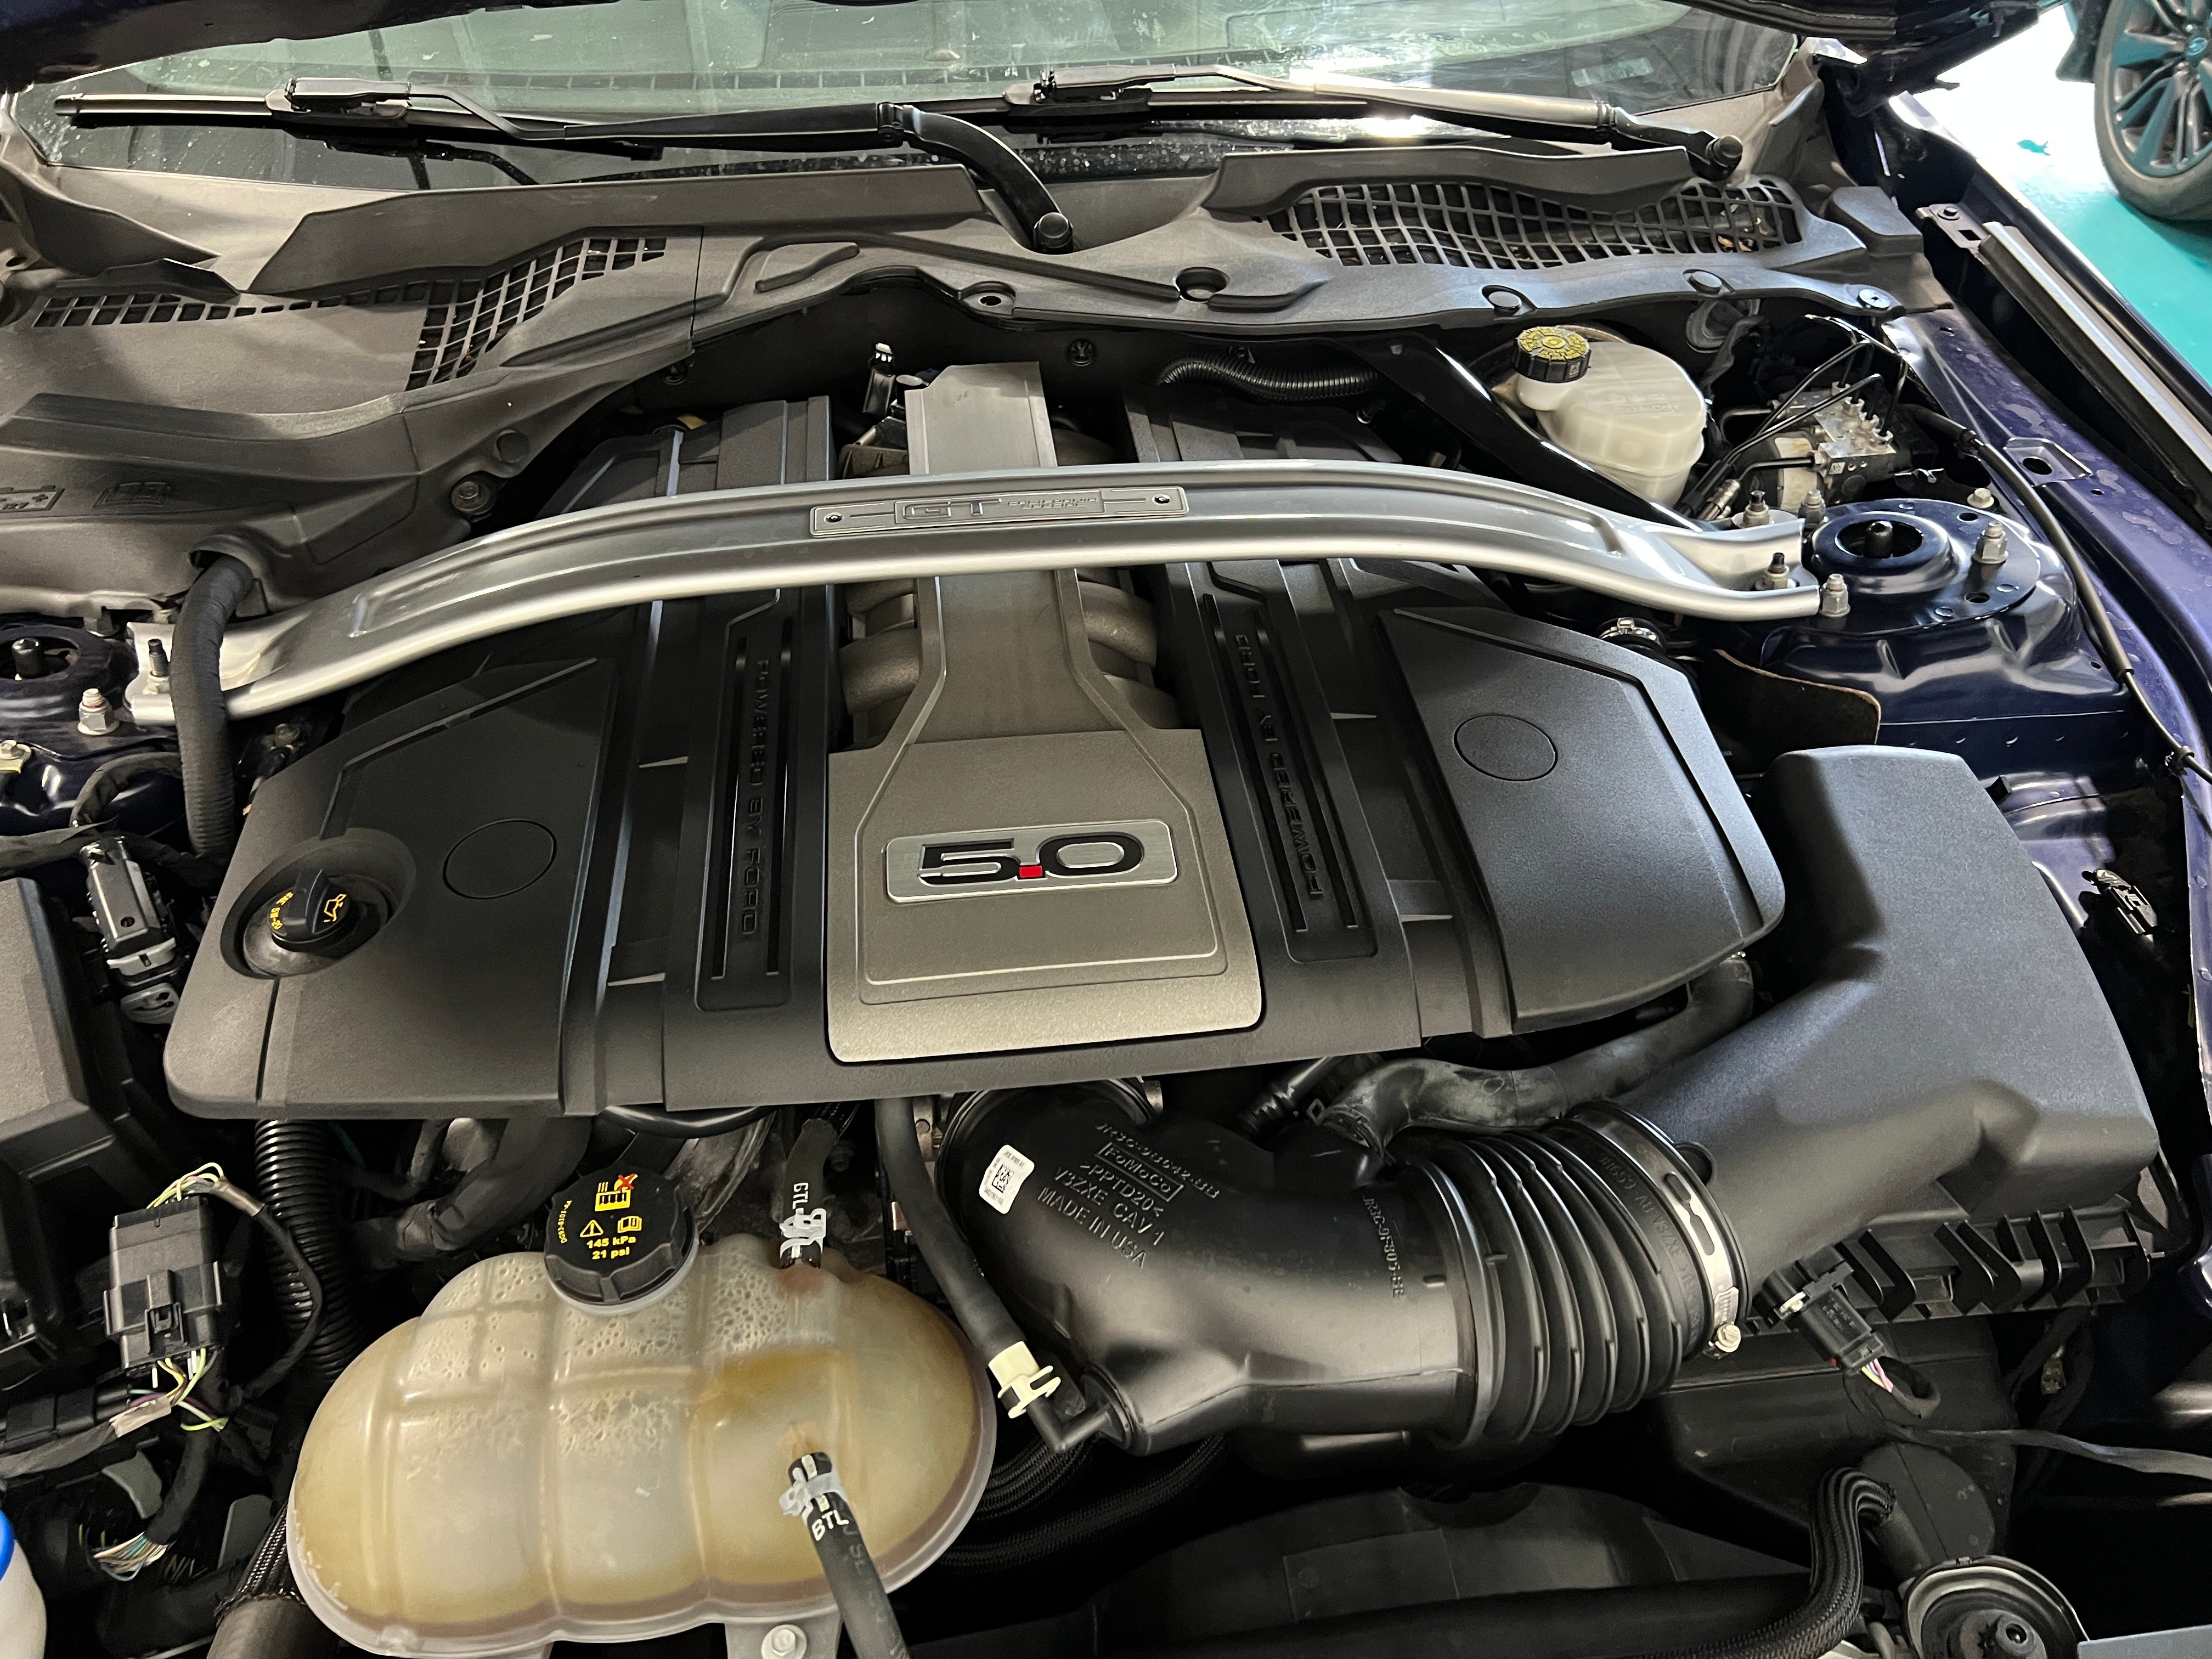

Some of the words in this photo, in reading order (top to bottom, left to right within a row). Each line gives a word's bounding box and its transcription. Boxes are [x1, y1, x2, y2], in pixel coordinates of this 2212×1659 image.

[903, 498, 1002, 520] GT
[750, 658, 770, 787] POWERED
[747, 797, 764, 834] BY
[1271, 752, 1324, 895] POWERED
[918, 831, 1144, 887] 5.0
[741, 847, 761, 936] FORD
[1104, 1147, 1171, 1193] FoMoCo
[1037, 1187, 1091, 1226] MADE
[1088, 1216, 1111, 1239] IN
[1111, 1229, 1147, 1270] USA
[1054, 1166, 1109, 1206] V3ZXE
[1113, 1202, 1153, 1234] CAV
[1153, 1231, 1165, 1246] 1
[586, 1238, 610, 1249] 145
[612, 1235, 636, 1245] kPa
[592, 1250, 607, 1260] 21
[611, 1246, 630, 1259] psi
[811, 1509, 850, 1541] BTL
